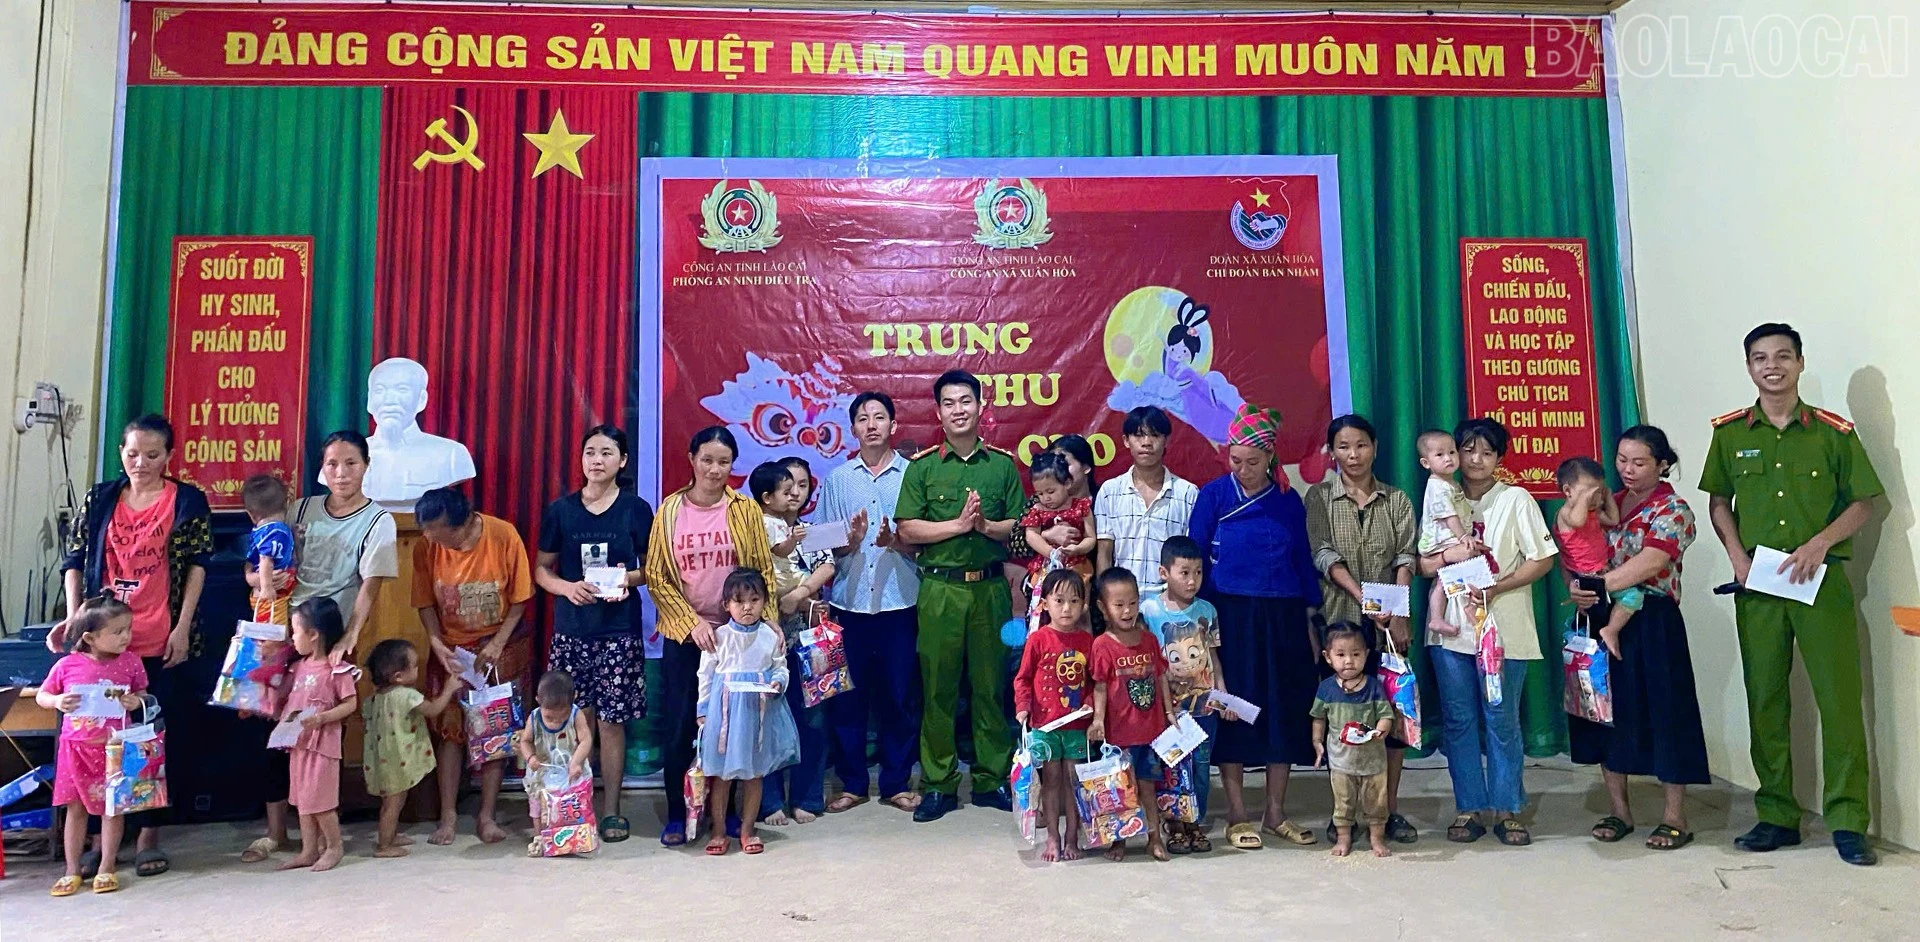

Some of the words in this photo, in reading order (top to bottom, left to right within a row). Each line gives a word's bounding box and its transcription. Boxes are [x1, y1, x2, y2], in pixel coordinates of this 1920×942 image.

[224, 18, 368, 66] ĐẢNG
[387, 27, 527, 74] CỘNG
[545, 23, 656, 71] SẢN
[669, 31, 774, 80] VIỆT
[791, 43, 908, 78] NAM
[922, 41, 1088, 80] QUANG
[1103, 43, 1214, 78] VINH
[1235, 34, 1378, 77] MUÔN
[1394, 32, 1506, 78] NĂM
[200, 250, 248, 280] SUỐT
[253, 253, 284, 280] ĐỜI
[717, 263, 732, 272] AN
[1243, 253, 1257, 264] XÃ
[1260, 253, 1290, 264] XUÂN
[1502, 252, 1550, 275] SỐNG,
[715, 276, 732, 286] AN
[734, 276, 761, 285] NINH
[950, 268, 982, 278] CÔNG
[1002, 267, 1017, 278] XÃ
[1019, 267, 1049, 278] XUÂN
[1207, 269, 1226, 278] CHI
[1483, 278, 1530, 299] CHIẾN
[1534, 277, 1571, 300] ĐẤU,
[200, 294, 225, 316] HY
[230, 294, 280, 318] SINH,
[1490, 308, 1519, 324] LAO
[1524, 305, 1566, 327] ĐỘNG
[191, 322, 242, 352] PHẤN
[248, 322, 286, 351] ĐẤU
[863, 322, 1032, 356] TRUNG
[1484, 333, 1505, 349] VÀ
[1510, 334, 1540, 353] HỌC
[1545, 331, 1575, 353] TẬP
[218, 366, 255, 389] CHO
[1482, 360, 1522, 375] THEO
[1527, 359, 1580, 375] GƯƠNG
[1497, 379, 1529, 402] CHỦ
[1533, 385, 1568, 405] TỊCH
[190, 398, 212, 426] LÝ
[218, 394, 279, 425] TƯỞNG
[1511, 410, 1537, 427] CHÍ
[1542, 411, 1584, 427] MINH
[184, 436, 236, 467] CỘNG
[242, 430, 281, 462] SẢN
[1017, 433, 1116, 467] CO
[1513, 437, 1528, 454] VĨ
[1532, 437, 1559, 458] ĐẠI
[271, 540, 283, 558] 12
[678, 533, 694, 551] JE
[682, 554, 696, 571] JE
